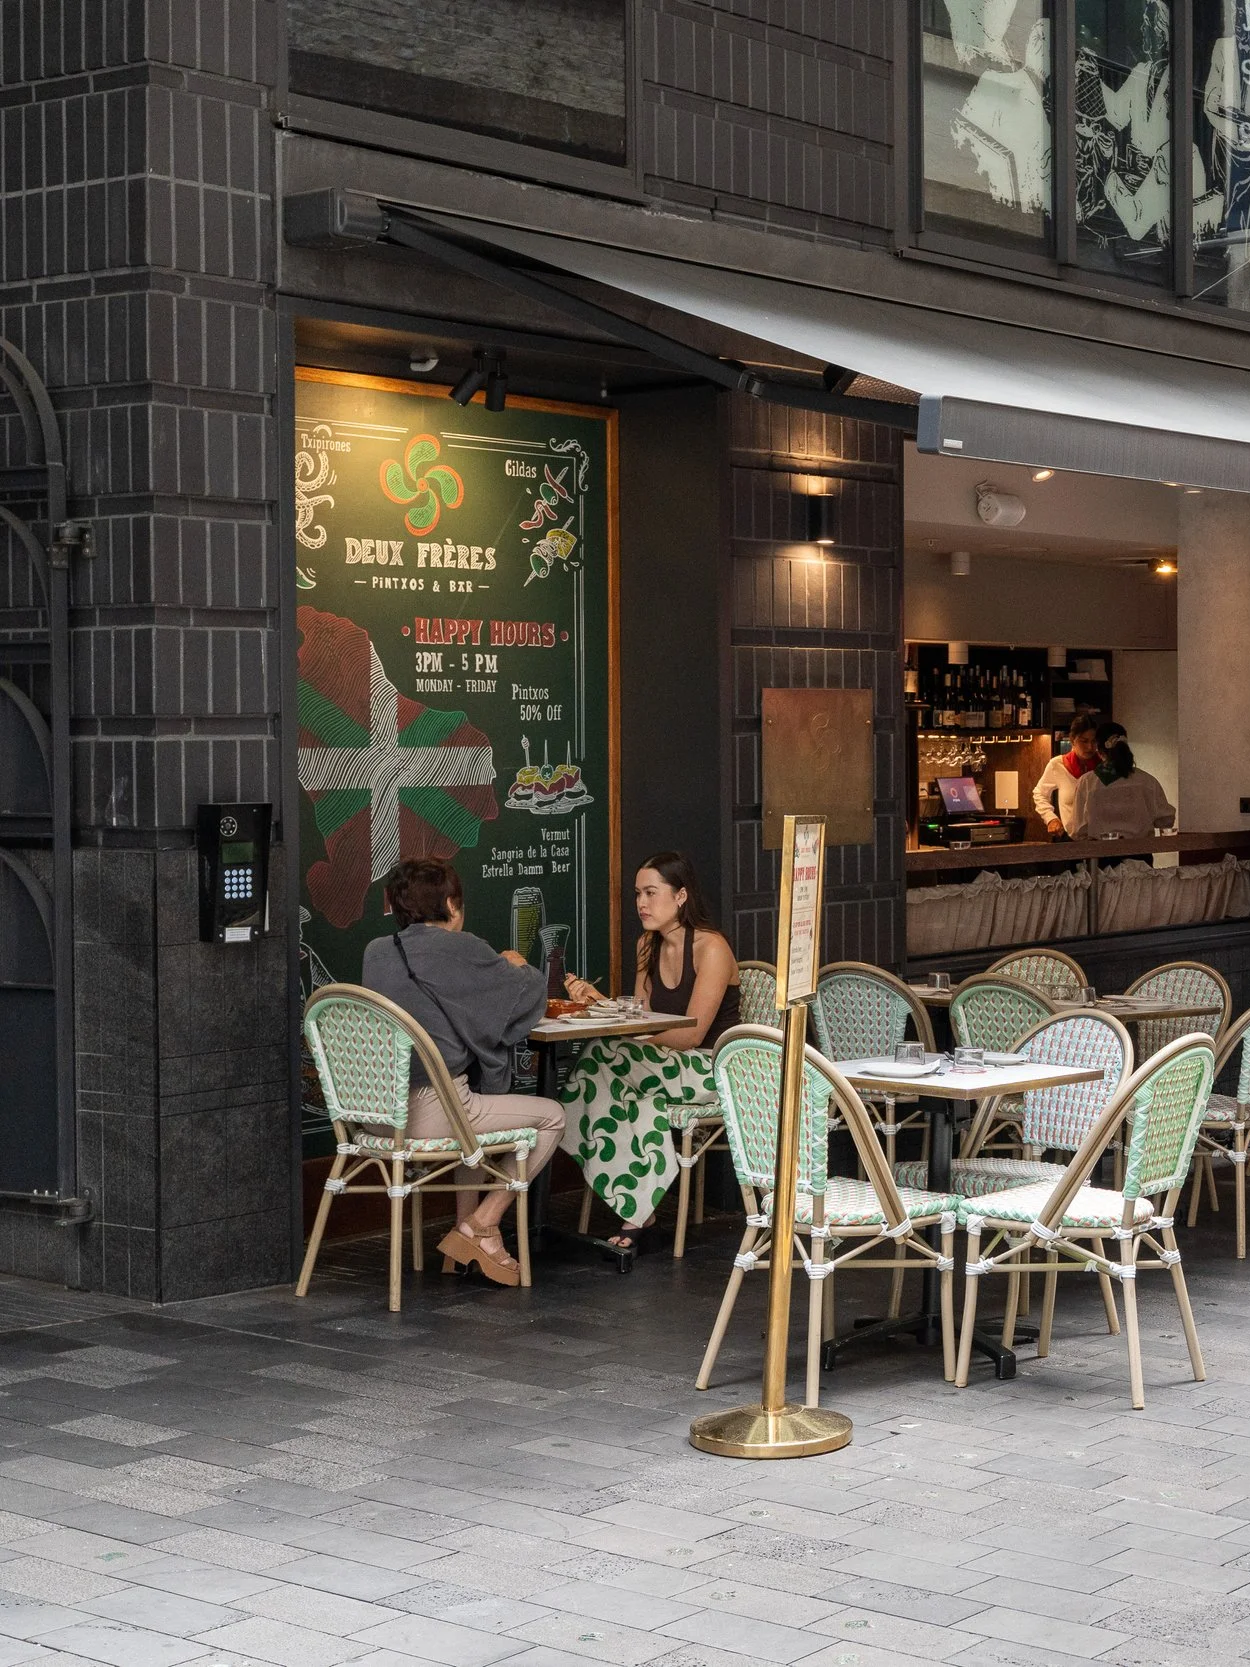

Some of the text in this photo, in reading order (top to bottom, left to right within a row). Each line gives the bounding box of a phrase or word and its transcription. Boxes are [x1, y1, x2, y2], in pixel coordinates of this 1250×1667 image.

[300, 433, 351, 454] Txipirones
[505, 459, 537, 479] Gildas
[345, 537, 497, 571] DEUX FRÈRES
[432, 580, 440, 593] &
[449, 580, 473, 593] BAR
[415, 617, 556, 648] HAPPY HOURS
[415, 651, 443, 673] 3PM
[461, 653, 469, 671] 5
[475, 653, 498, 673] PM
[415, 678, 453, 693] MONDAY
[465, 679, 497, 693] FRIDAY
[511, 683, 549, 700] Pintxos
[520, 704, 563, 721] 50% Off
[541, 828, 569, 840] Vermut
[491, 844, 569, 863] Sangria de la Casa
[482, 860, 571, 878] Estrella Damm Beer
